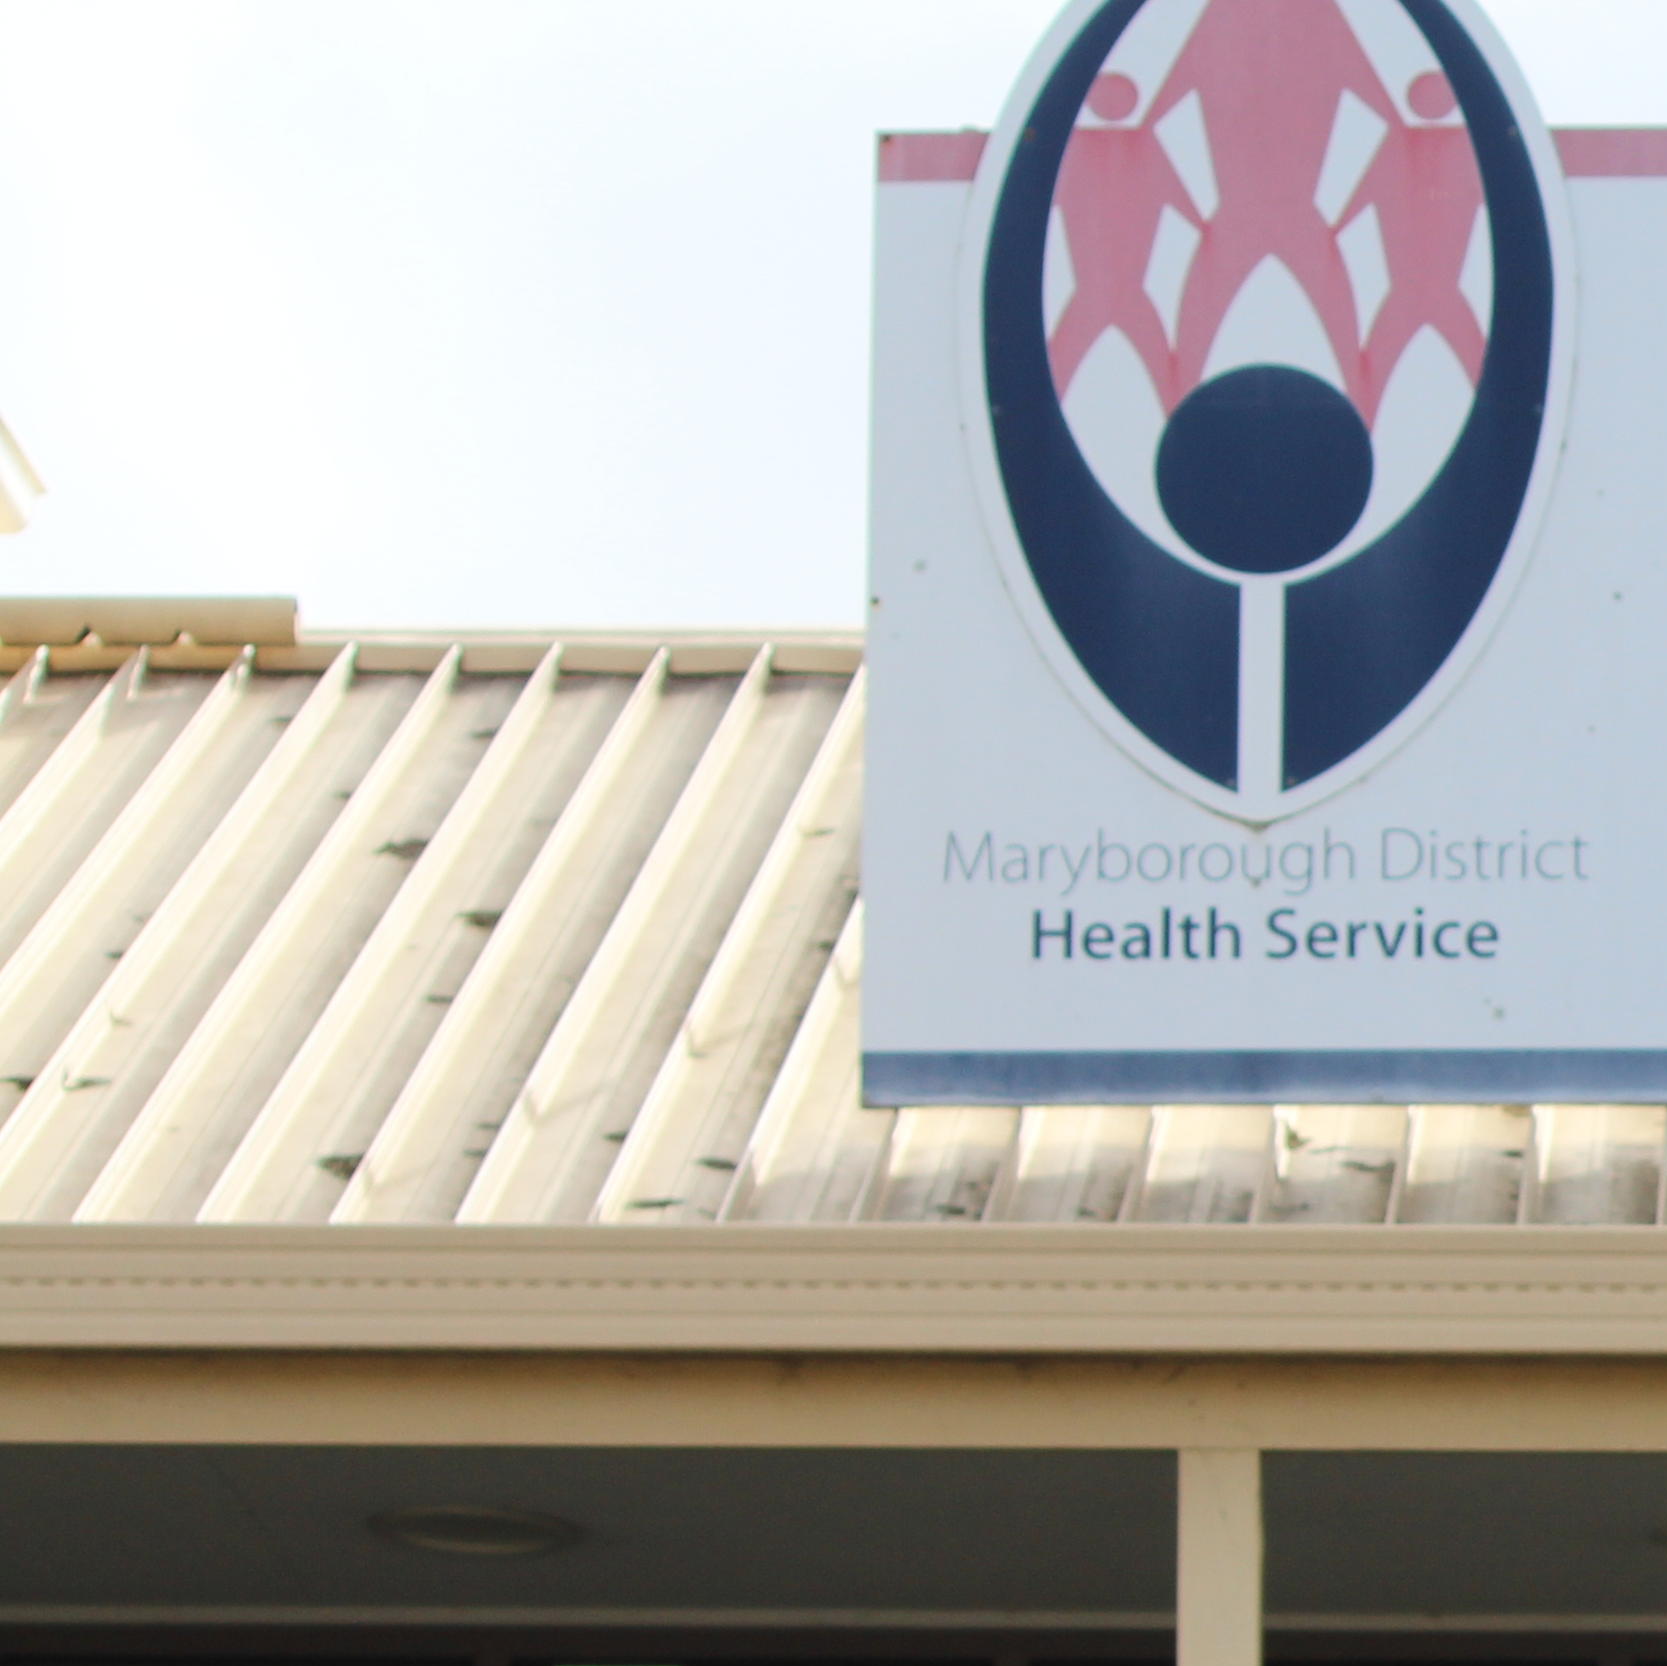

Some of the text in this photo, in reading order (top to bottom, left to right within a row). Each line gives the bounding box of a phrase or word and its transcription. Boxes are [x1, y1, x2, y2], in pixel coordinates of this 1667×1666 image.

[942, 827, 1590, 898] Maryborough District
[1031, 906, 1500, 961] Health Service
